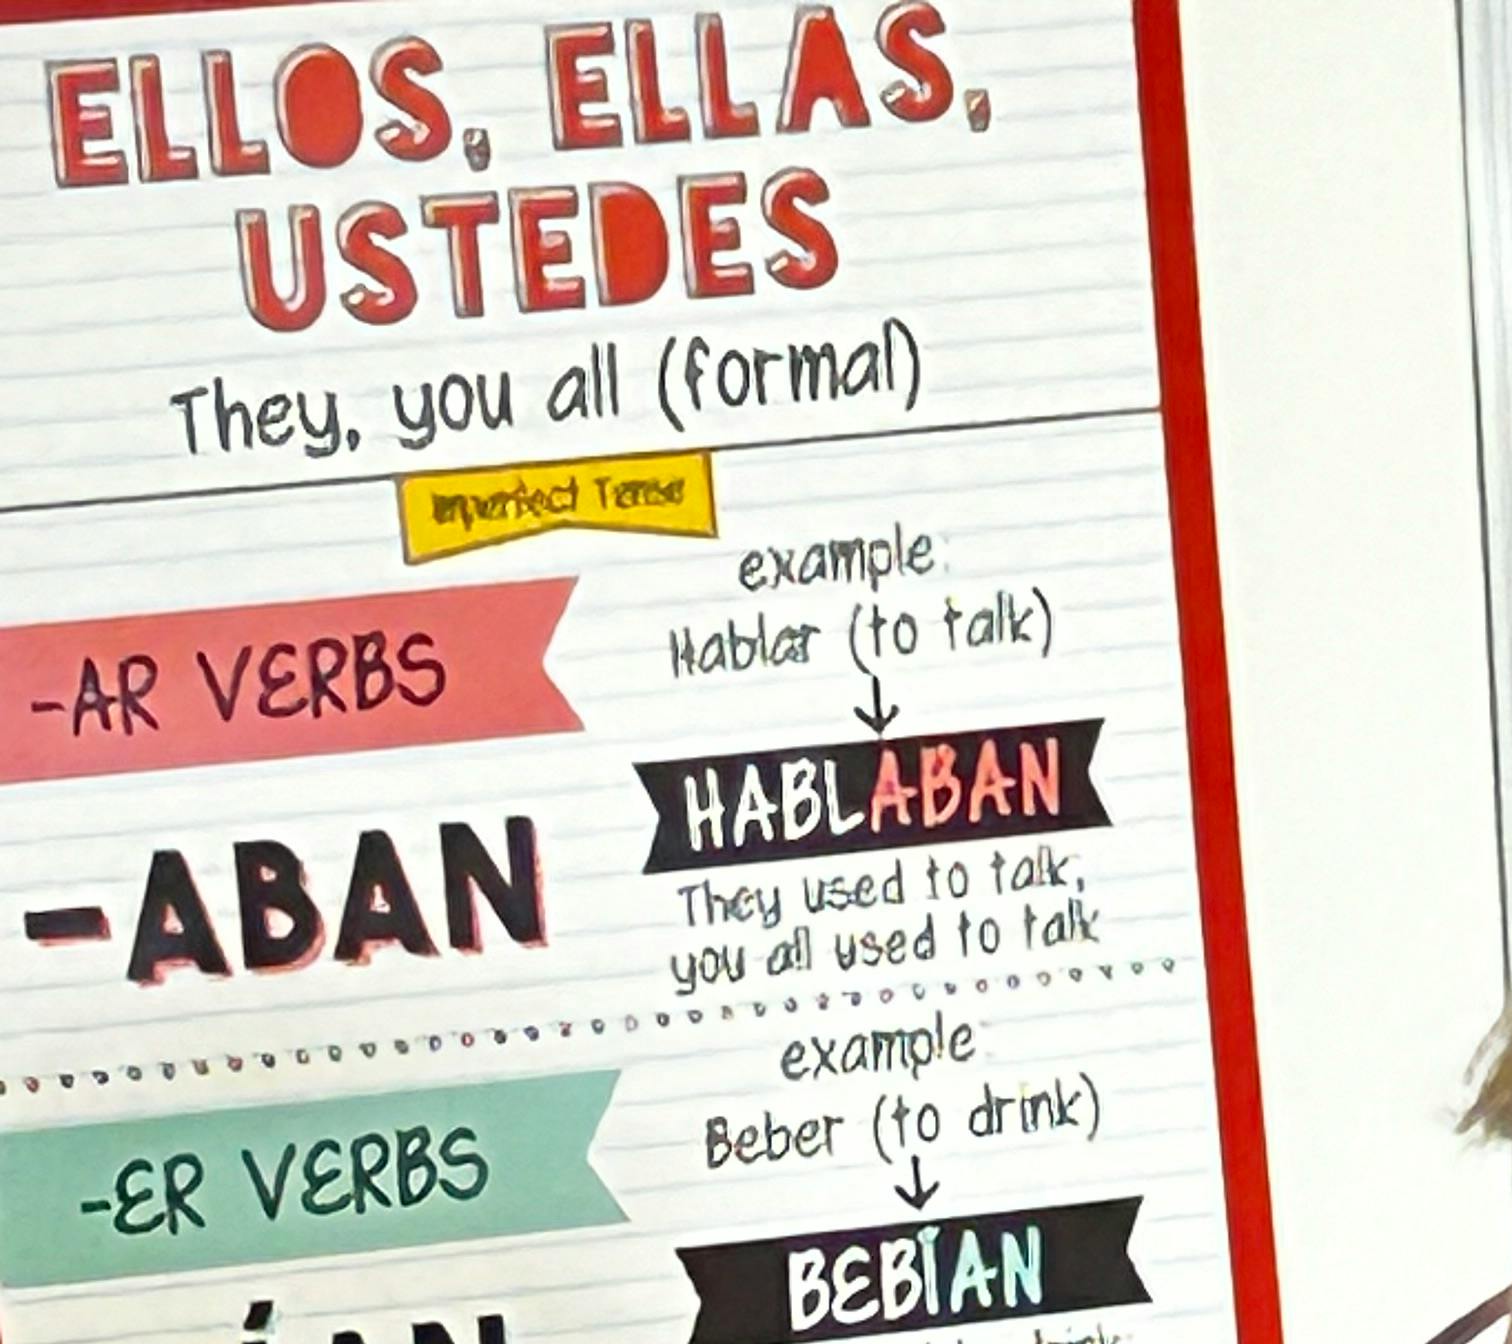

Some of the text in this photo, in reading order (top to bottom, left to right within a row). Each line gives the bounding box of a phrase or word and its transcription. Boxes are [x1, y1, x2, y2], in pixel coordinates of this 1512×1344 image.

[45, 1, 991, 189] ELLOS, ELLAS,
[234, 166, 838, 333] USTEDES
[170, 318, 919, 457] They, you all (formal)
[31, 630, 445, 736] -AR VERBS
[669, 587, 1052, 678] Hablar (to talk)
[683, 737, 1061, 851] HABLABAN
[24, 815, 548, 987] -ABAN
[678, 845, 1086, 930] They used to talk,
[670, 898, 1100, 997] you all used to talk
[705, 1072, 1100, 1169] Beber (to drink)
[81, 1125, 489, 1235] -ER VERBS
[788, 1226, 1043, 1331] BEBÍAN
